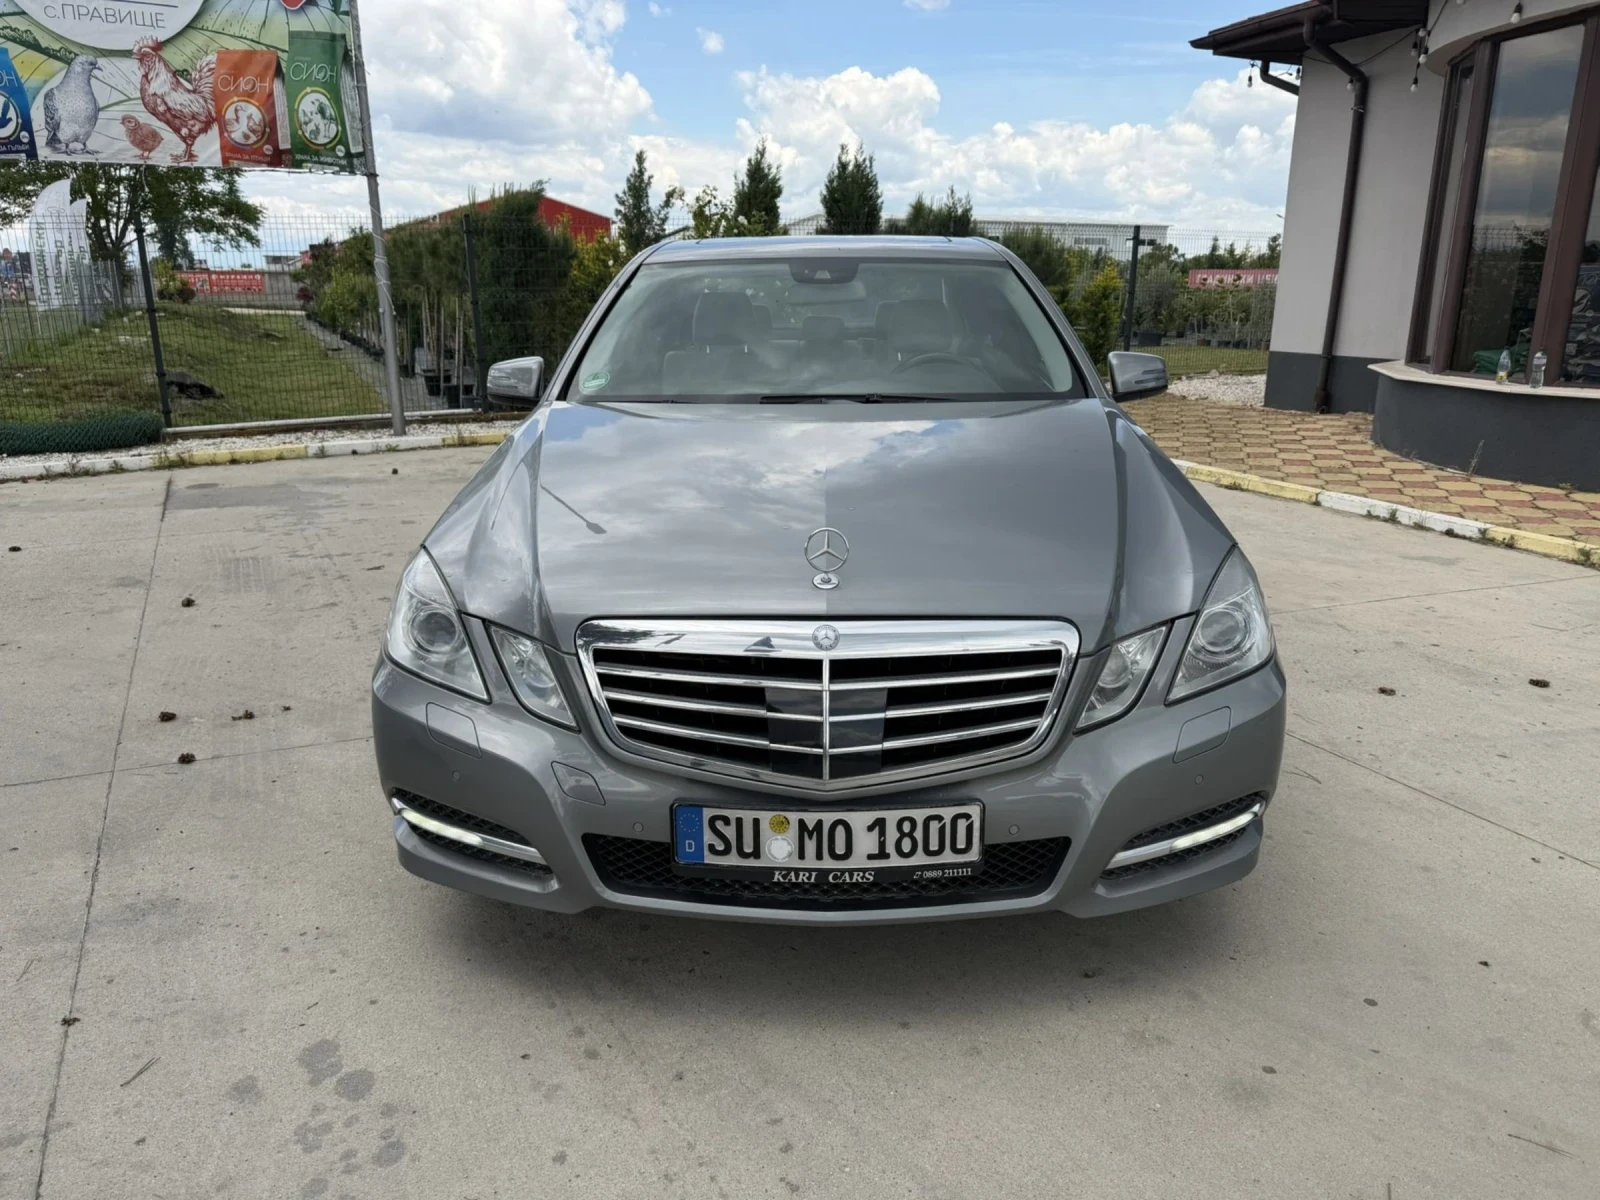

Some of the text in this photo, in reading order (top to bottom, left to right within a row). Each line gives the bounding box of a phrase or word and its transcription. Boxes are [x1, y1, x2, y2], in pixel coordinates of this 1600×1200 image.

[290, 62, 337, 84] СИОН
[217, 74, 270, 93] СИОН
[707, 812, 974, 861] SU MO 1800
[685, 840, 695, 852] D
[772, 870, 875, 883] KARI CARS
[922, 868, 972, 879] 0889 211111
